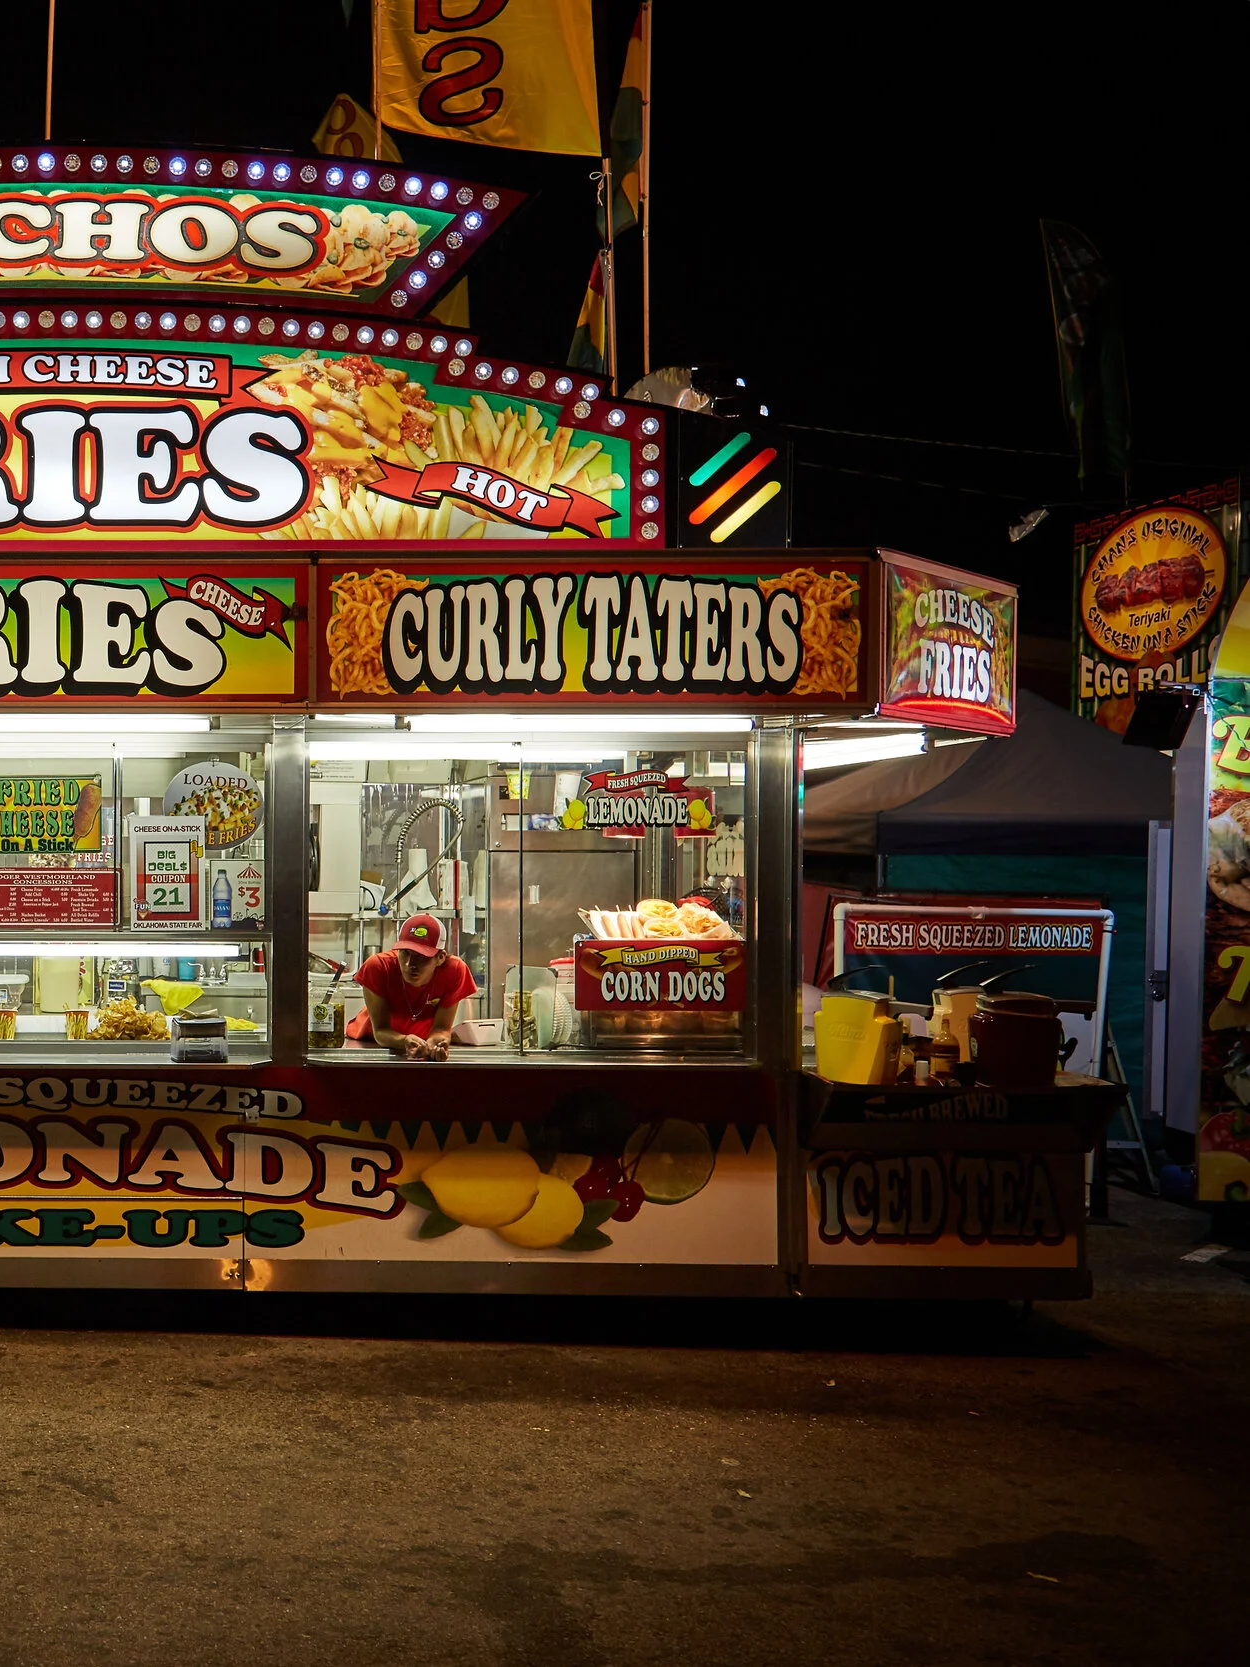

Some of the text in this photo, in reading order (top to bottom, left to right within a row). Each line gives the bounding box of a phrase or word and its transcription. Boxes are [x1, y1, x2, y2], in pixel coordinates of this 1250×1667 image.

[20, 354, 217, 389] CHEESE
[451, 464, 548, 522] HOT
[1091, 517, 1211, 583] CHAN'S ORIGINAL
[188, 577, 264, 628] CHEESE
[1088, 581, 1216, 651] CHICKEN ON A STICK
[1128, 606, 1171, 628] Teriyaki
[385, 573, 801, 689] CURLY TATERS
[914, 589, 996, 648] CHEESE
[917, 638, 991, 703] FRIES
[1080, 653, 1130, 699] EGG
[183, 773, 248, 789] LOADED
[607, 772, 666, 789] FRESH SQUEEZED
[586, 796, 689, 827] LEMONADE
[134, 825, 202, 833] CHEESE ON-A-STICK
[218, 817, 257, 845] FRIES
[1, 838, 74, 852] On A Stick
[157, 851, 176, 860] BIG
[151, 874, 186, 883] COUPON
[152, 887, 184, 906] 21
[238, 886, 261, 908] $3
[855, 921, 1094, 952] FRESH SQUEEZED LEMONADE
[625, 947, 697, 964] HAND DIPPED
[601, 971, 726, 1002] CORN DOGS
[819, 1153, 1063, 1241] ICED TEA
